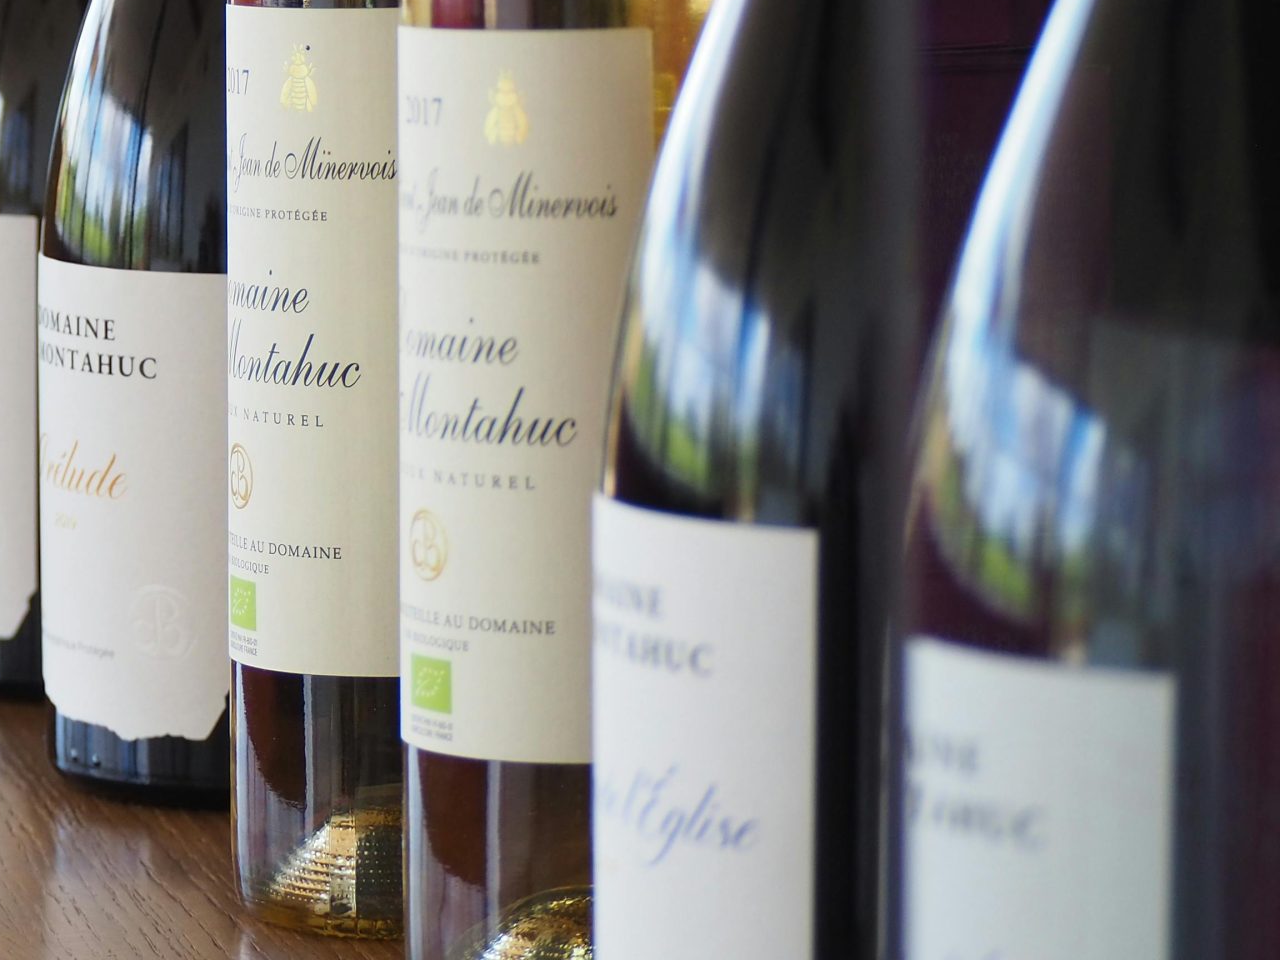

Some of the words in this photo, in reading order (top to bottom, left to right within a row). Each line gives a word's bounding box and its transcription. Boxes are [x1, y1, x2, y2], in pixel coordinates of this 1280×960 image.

[406, 96, 443, 126] 2017
[265, 141, 281, 178] de
[464, 175, 483, 217] de
[488, 170, 619, 219] Minervois
[265, 208, 328, 221] PROTÉGÉE
[228, 269, 310, 314] omaine
[405, 317, 519, 366] omaine
[243, 407, 324, 428] NATUREL
[434, 467, 536, 490] NATUREL
[250, 538, 265, 553] AU
[268, 542, 342, 560] DOMAINE
[444, 614, 463, 629] AU
[468, 616, 557, 636] DOMAINE
